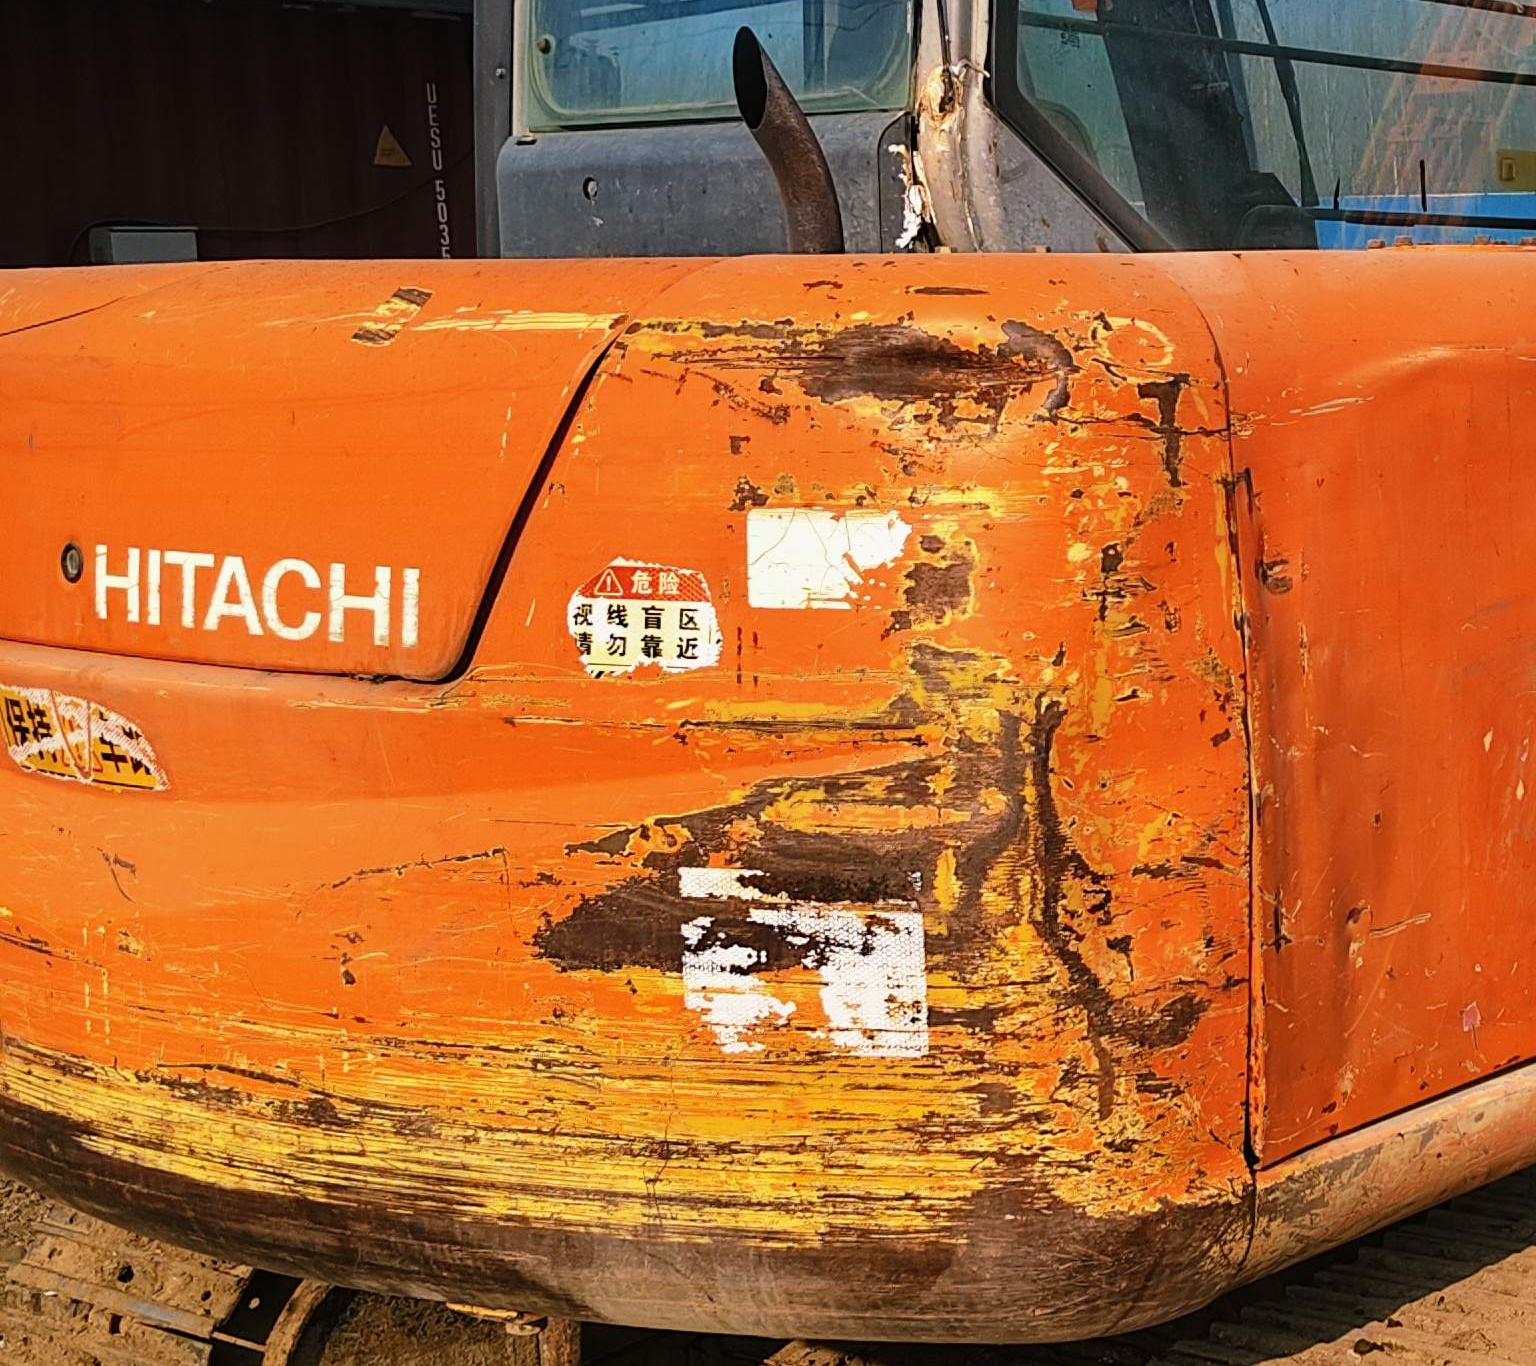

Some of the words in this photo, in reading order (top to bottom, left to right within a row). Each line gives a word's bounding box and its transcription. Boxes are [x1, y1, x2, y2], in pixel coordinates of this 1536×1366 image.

[95, 544, 420, 648] HITACHI
[631, 570, 681, 595] 危险
[572, 603, 701, 631] 视线盲区
